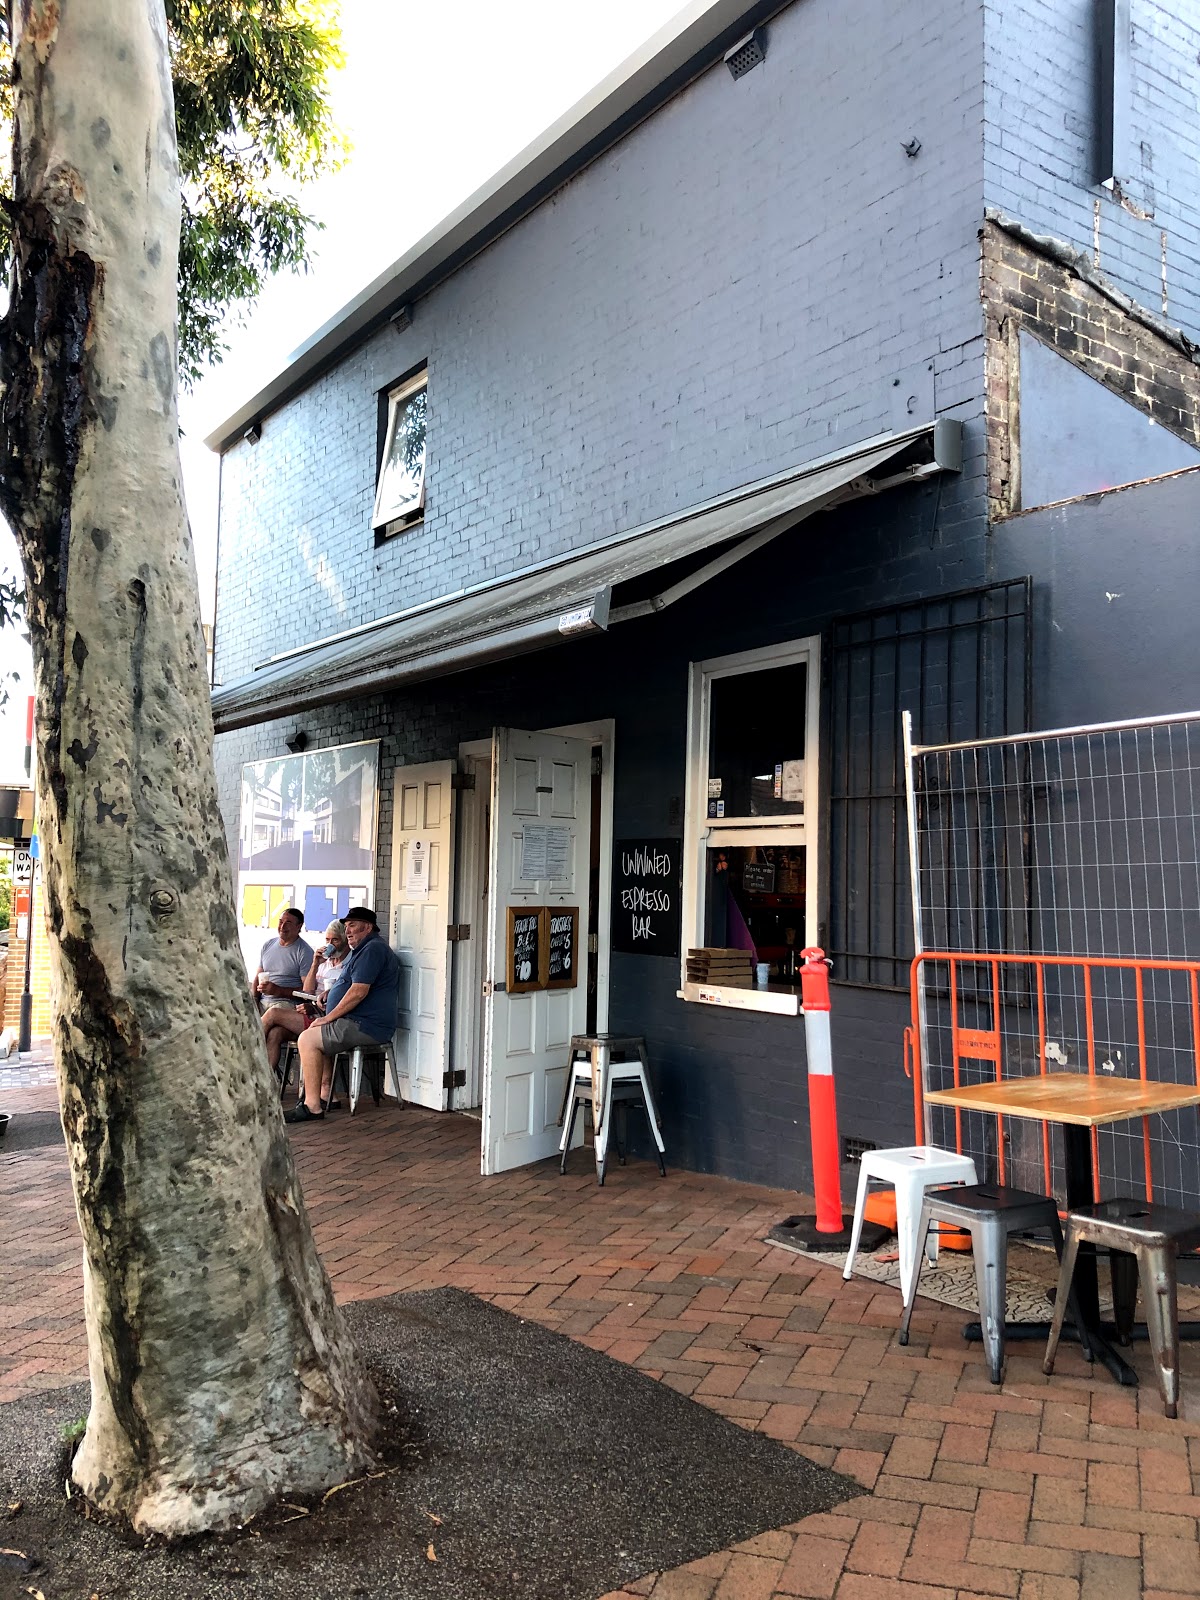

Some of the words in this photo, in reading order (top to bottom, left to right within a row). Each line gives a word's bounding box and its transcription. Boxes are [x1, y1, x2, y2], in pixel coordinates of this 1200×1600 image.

[622, 845, 671, 877] UNWINED
[621, 886, 670, 911] ESPRESSO
[632, 913, 657, 940] BAR
